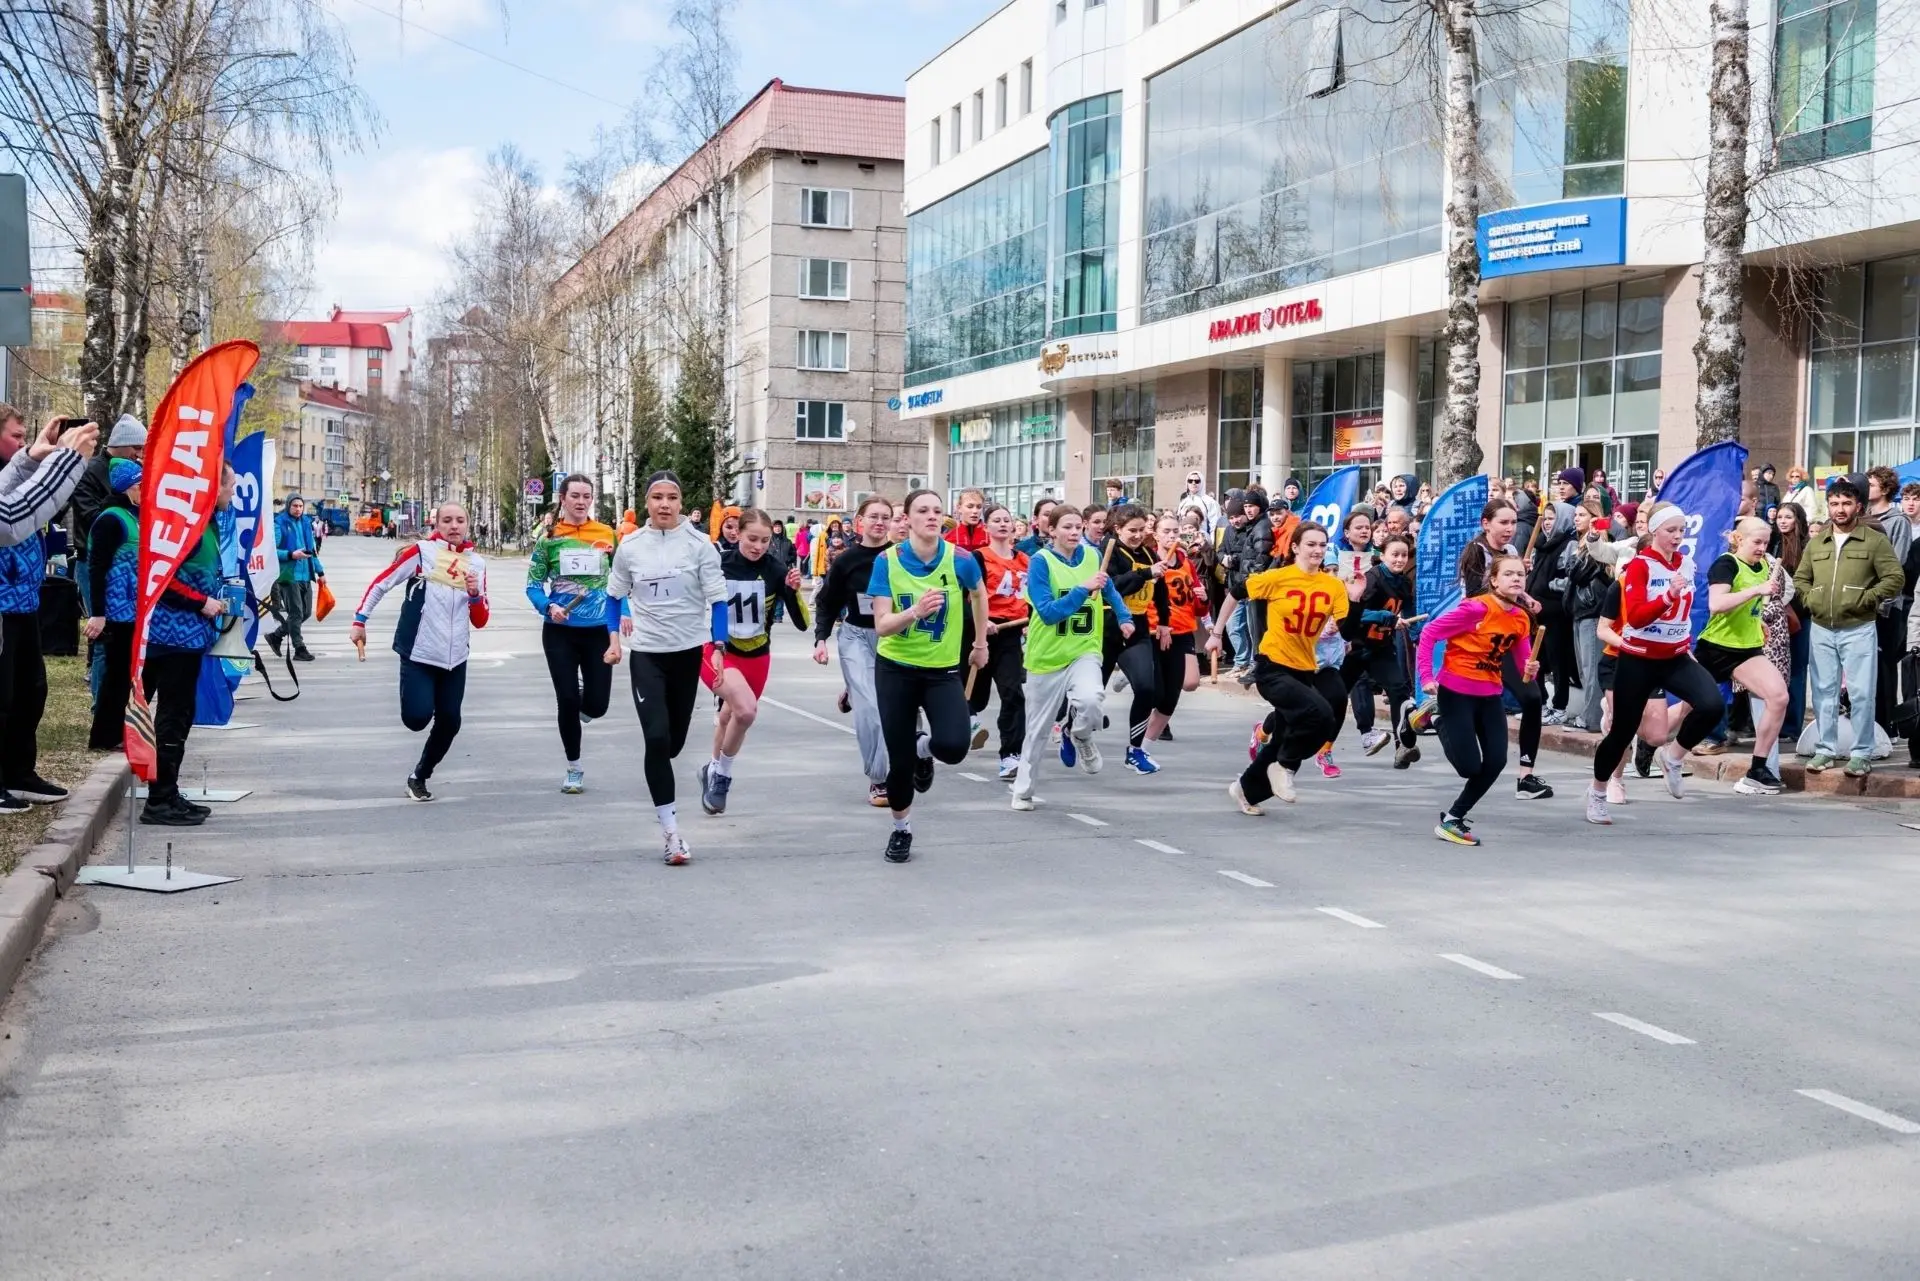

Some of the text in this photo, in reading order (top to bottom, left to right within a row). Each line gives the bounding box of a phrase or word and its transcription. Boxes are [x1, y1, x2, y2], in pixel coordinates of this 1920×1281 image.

[1552, 238, 1581, 252] СЕТЕЙ
[1209, 299, 1322, 341] АВАЛОН ОТЕЛЬ
[571, 558, 580, 570] 5
[940, 574, 948, 586] 1
[649, 582, 659, 597] 7
[728, 592, 759, 624] 11
[898, 590, 949, 642] 14
[1055, 588, 1095, 636] 15
[1283, 590, 1331, 637] 36
